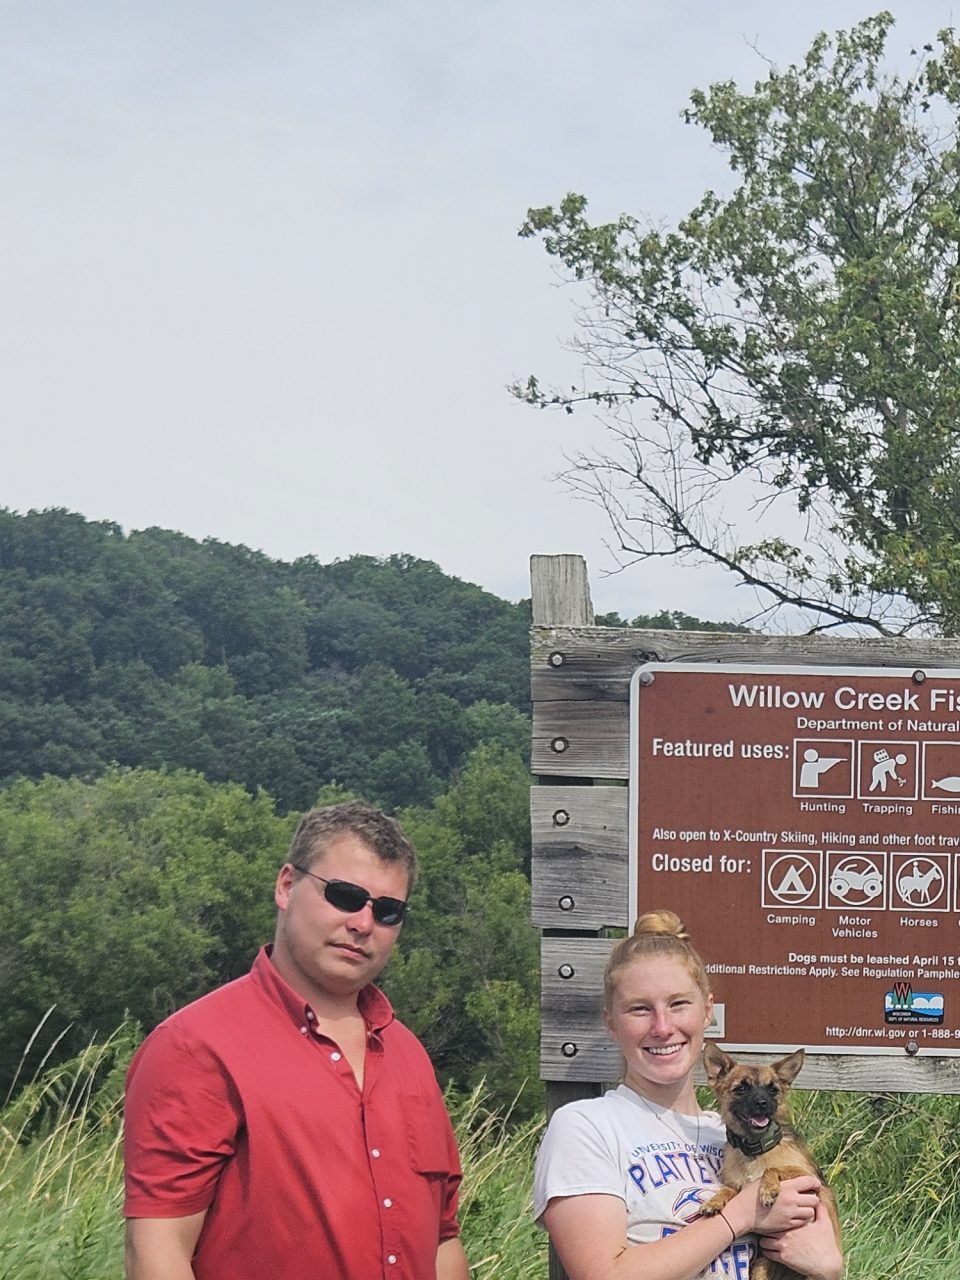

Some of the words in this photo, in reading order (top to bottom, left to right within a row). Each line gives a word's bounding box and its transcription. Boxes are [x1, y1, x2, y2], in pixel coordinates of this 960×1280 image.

[728, 684, 825, 709] Willow
[834, 686, 920, 711] Creek
[797, 716, 884, 732] Department
[888, 719, 903, 731] of
[907, 719, 960, 733] Natural
[652, 738, 734, 758] Featured
[741, 744, 789, 759] uses:
[800, 801, 846, 814] Hunting
[862, 802, 913, 816] Trapping
[652, 828, 677, 840] Also
[679, 831, 706, 843] open
[709, 829, 721, 842] to
[723, 829, 778, 845] X-Country
[780, 830, 818, 846] Skiing,
[821, 831, 856, 847] Hiking
[858, 833, 880, 845] and
[882, 833, 912, 846] other
[913, 833, 936, 846] foot
[652, 853, 713, 873] Closed
[719, 855, 751, 874] for:
[766, 913, 816, 927] Camping
[838, 915, 872, 926] Motor
[900, 916, 938, 927] Horses
[831, 927, 878, 938] Vehicles
[788, 952, 817, 965] Dogs
[820, 955, 847, 964] must
[850, 953, 864, 964] be
[866, 954, 910, 965] leashed
[912, 955, 939, 968] April
[941, 955, 955, 966] 15
[705, 963, 746, 974] dditional
[748, 962, 808, 976] Restrictions
[808, 965, 838, 978] Apply.
[841, 966, 860, 977] See
[862, 966, 915, 979] Regulation
[825, 1026, 906, 1040] http://dnr.wi.gov
[908, 1030, 920, 1038] or
[700, 1144, 725, 1159] WISC
[628, 1152, 723, 1197] PLATTEV
